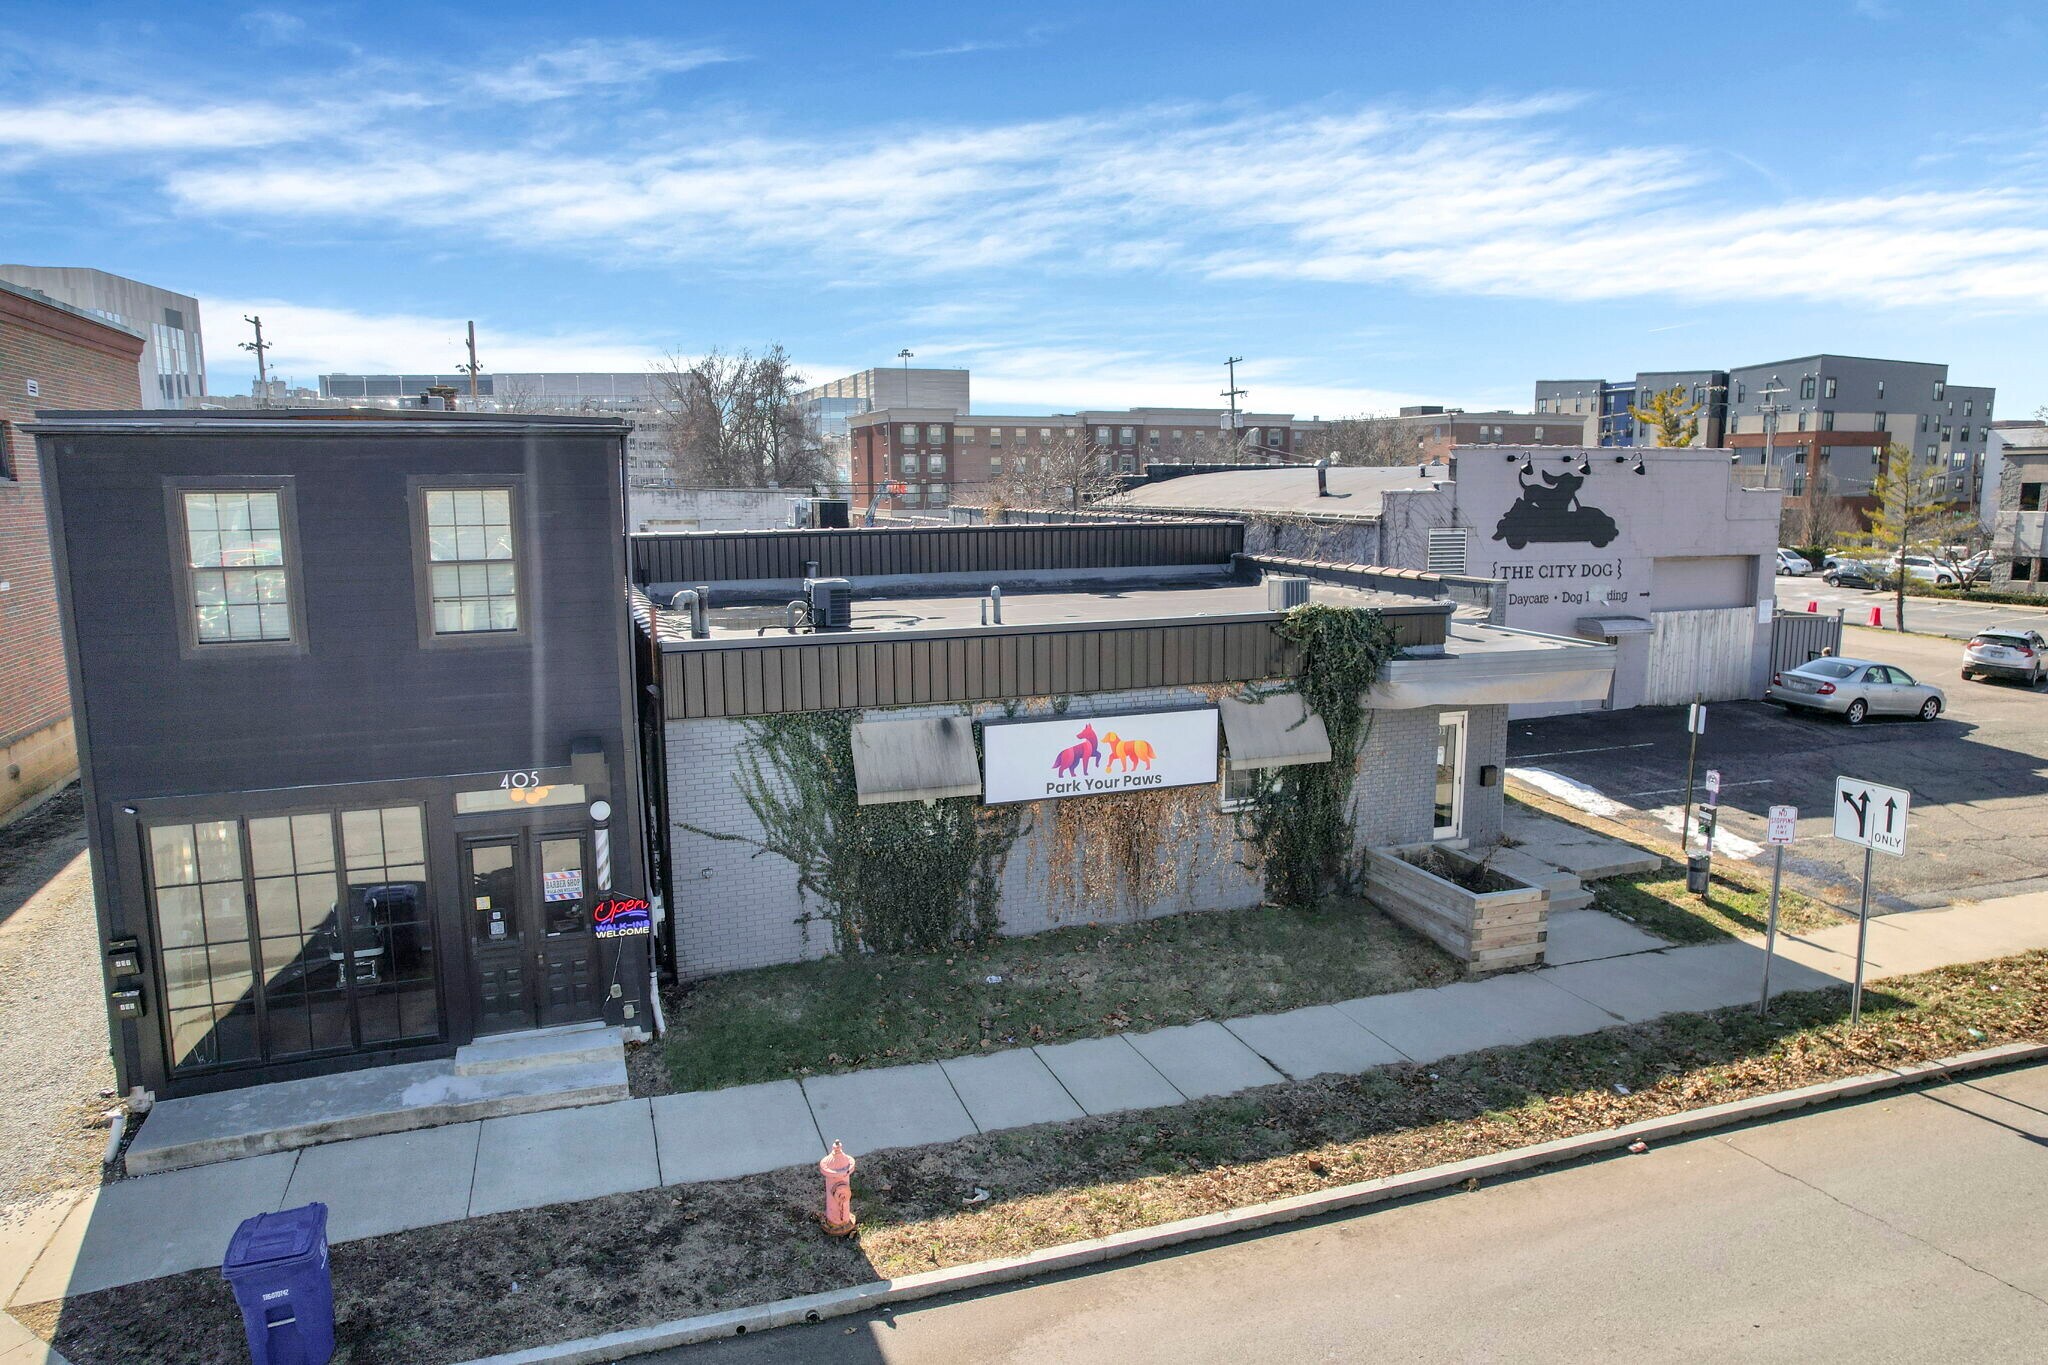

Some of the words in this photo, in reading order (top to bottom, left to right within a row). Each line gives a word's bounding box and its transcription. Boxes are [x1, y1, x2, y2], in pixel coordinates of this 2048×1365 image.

[1500, 565, 1534, 579] THE
[1538, 564, 1577, 579] CITY
[1581, 563, 1613, 578] DOG
[1508, 593, 1549, 607] Daycare
[1561, 591, 1583, 605] Dog
[1586, 589, 1628, 603] ding
[500, 771, 540, 790] 405
[1046, 780, 1081, 795] Park
[1084, 778, 1121, 791] Your
[1123, 774, 1162, 787] Paws
[1874, 832, 1901, 848] ONLY
[545, 879, 567, 889] BARBER
[567, 878, 581, 888] SHOP
[594, 899, 650, 923] Open
[595, 919, 651, 932] WALK-INS
[595, 926, 650, 939] WELCOME
